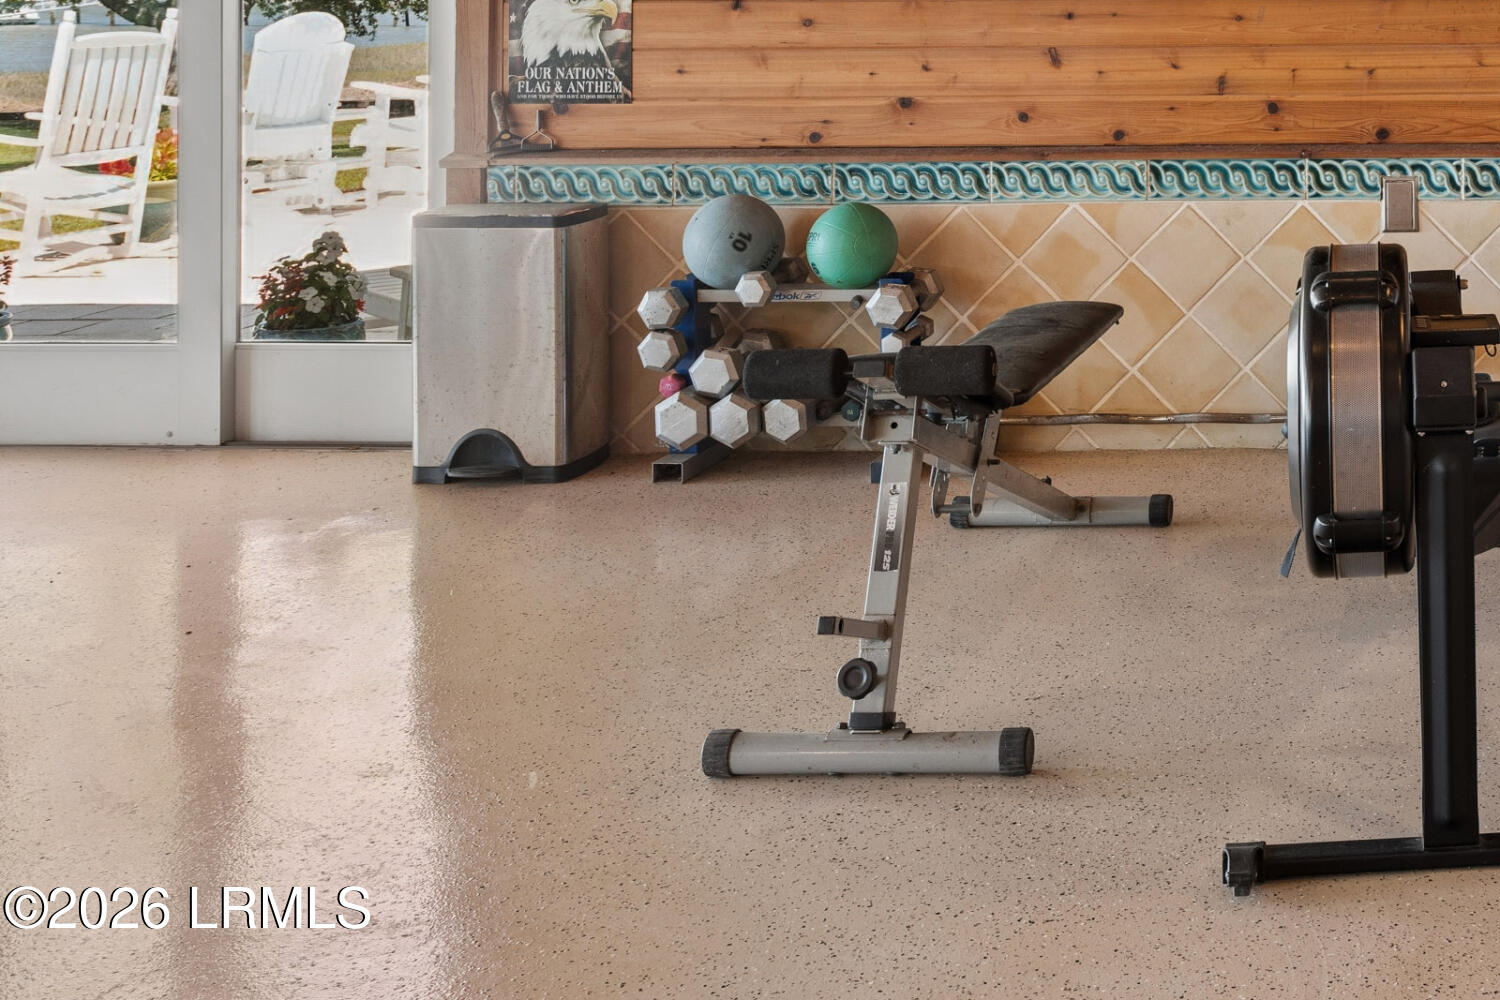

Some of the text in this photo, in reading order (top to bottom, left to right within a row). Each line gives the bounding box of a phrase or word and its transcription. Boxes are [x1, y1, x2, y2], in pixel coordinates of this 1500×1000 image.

[525, 67, 616, 80] OUR NATION'S
[517, 81, 623, 93] FLAG & ANTHEM
[732, 232, 753, 252] 10
[886, 495, 899, 531] WEIDER
[882, 549, 892, 571] 125
